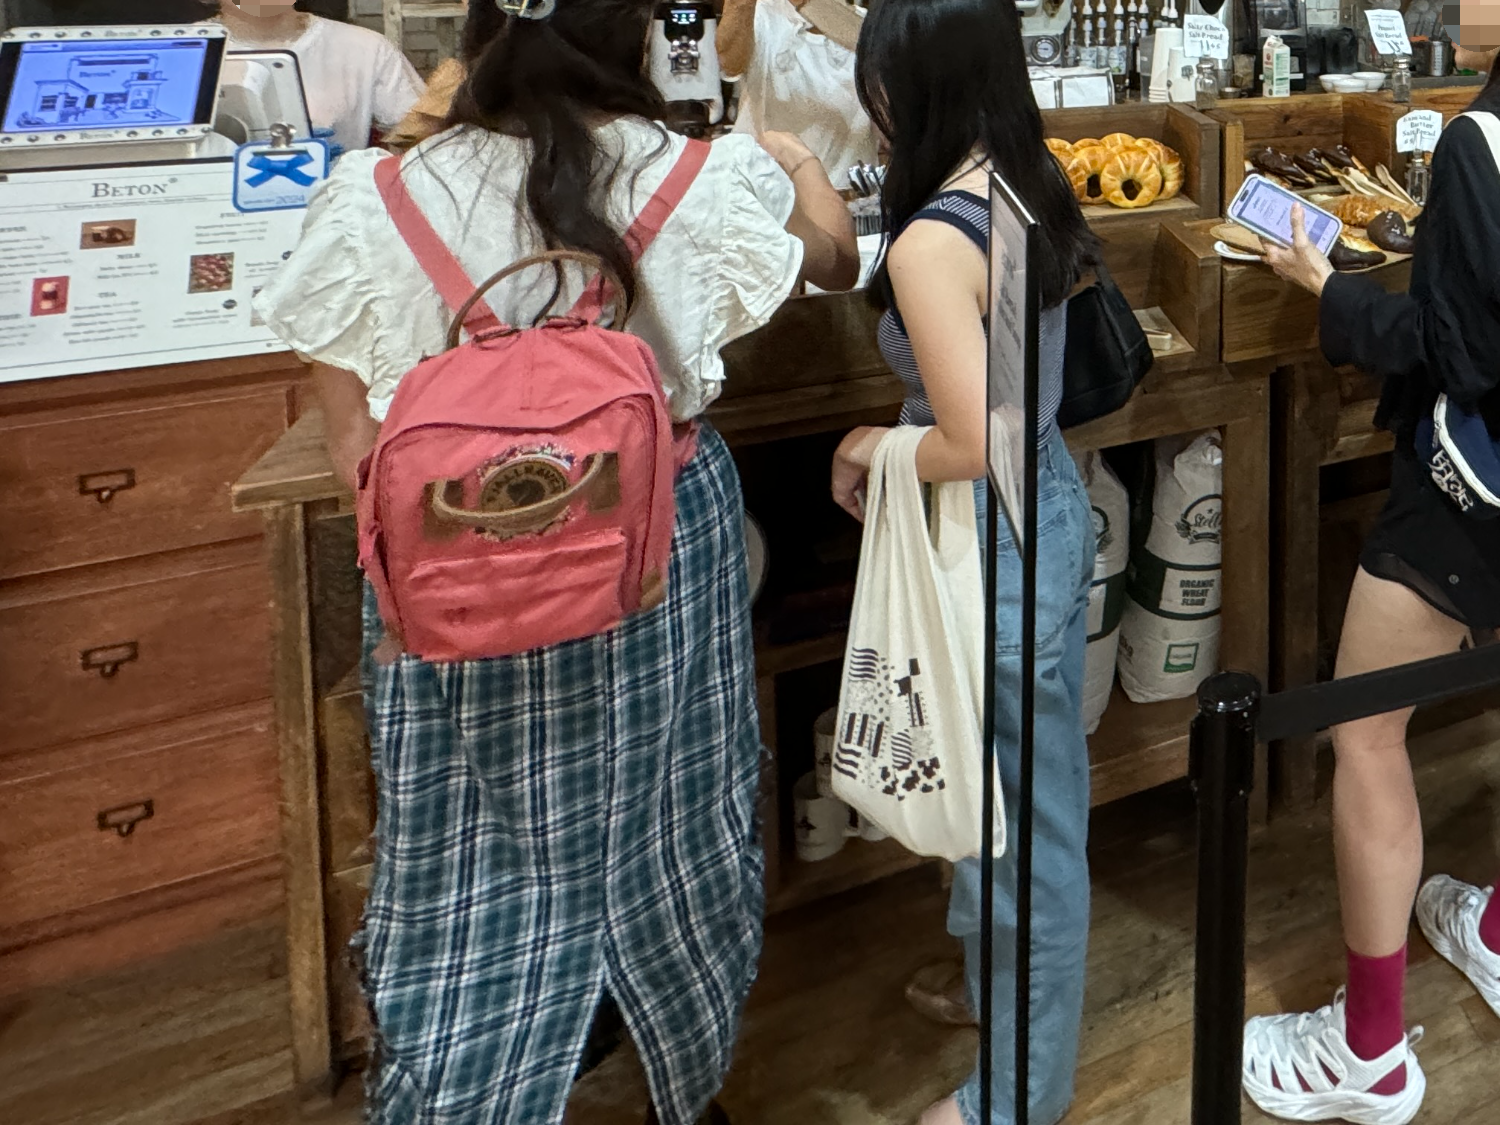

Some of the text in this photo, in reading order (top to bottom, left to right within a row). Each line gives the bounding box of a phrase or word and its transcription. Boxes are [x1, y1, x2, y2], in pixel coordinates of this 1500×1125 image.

[91, 181, 169, 199] BETON
[1179, 578, 1215, 589] ORGANIC
[1181, 588, 1210, 598] WHEAT
